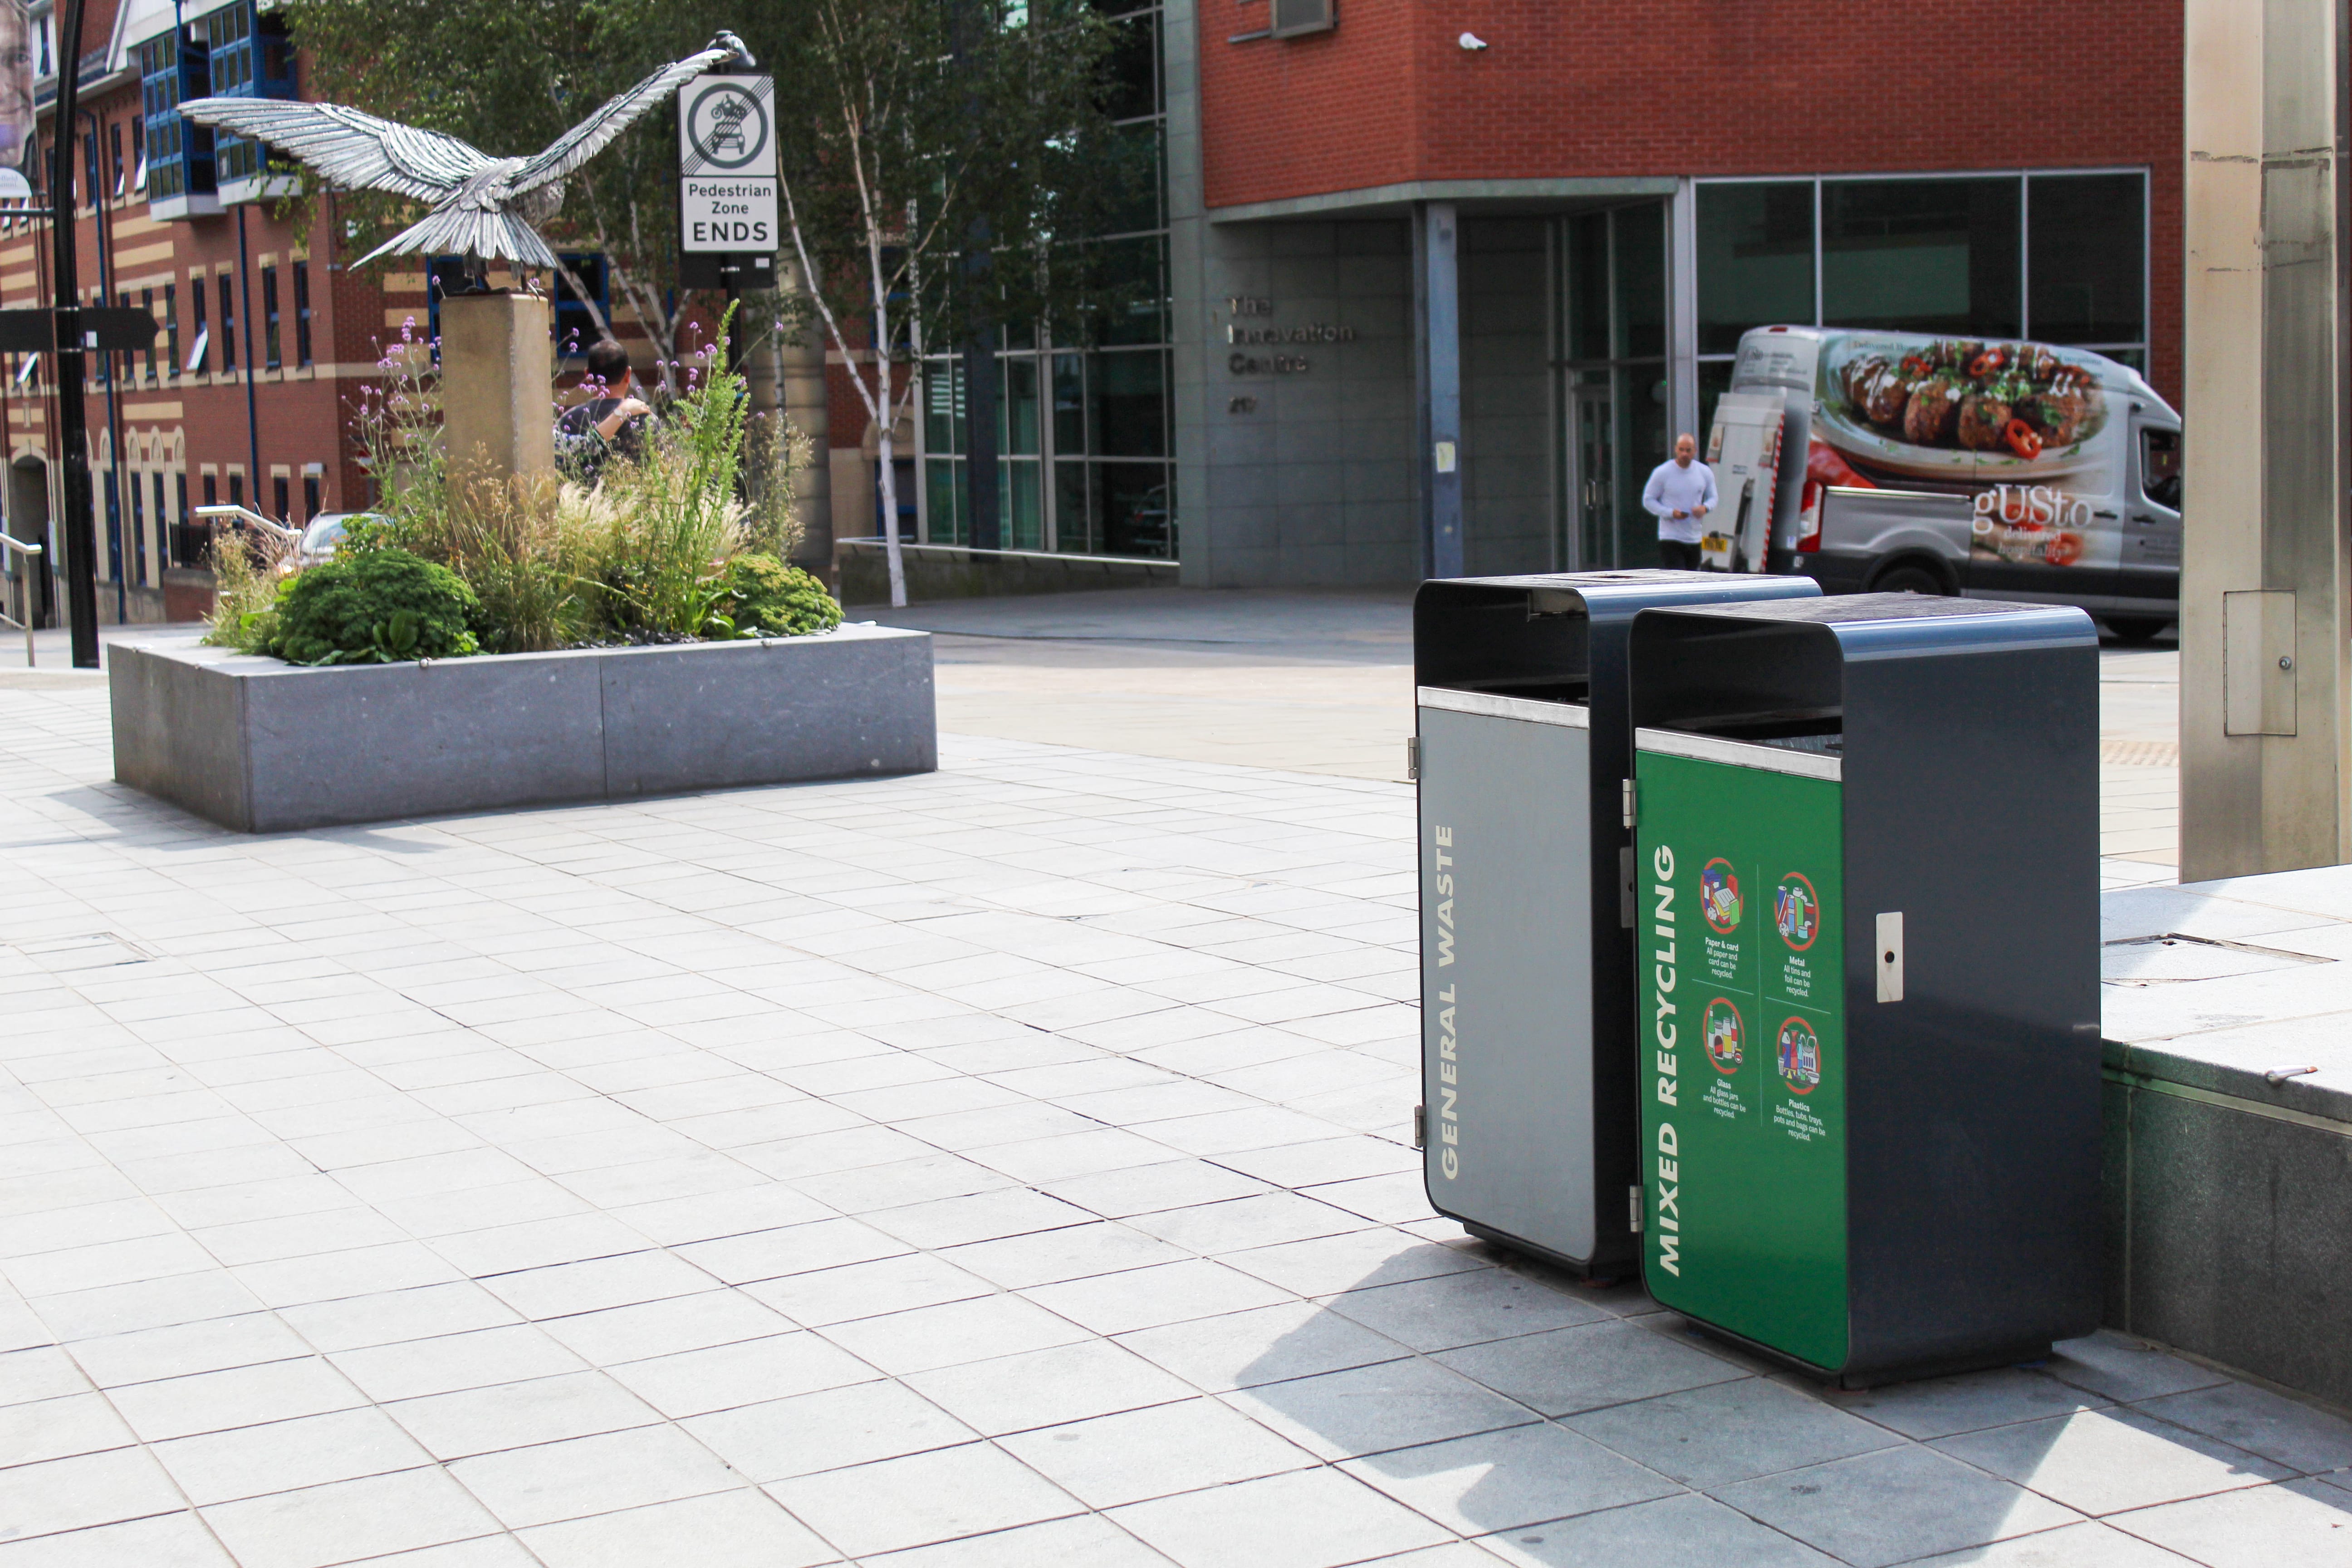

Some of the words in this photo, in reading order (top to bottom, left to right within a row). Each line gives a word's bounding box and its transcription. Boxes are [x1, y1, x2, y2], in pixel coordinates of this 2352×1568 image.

[689, 184, 771, 196] Pedestrian
[712, 201, 749, 214] Zone
[694, 222, 768, 241] ENDS
[2003, 526, 2061, 541] delivered
[1436, 825, 1455, 967] WASTE
[1705, 937, 1720, 947] Paper
[1721, 941, 1726, 949] &
[1713, 950, 1728, 958] paper
[1730, 961, 1736, 970] be
[1789, 956, 1805, 967] Metal
[1654, 845, 1677, 1106] RECYCLING
[1712, 969, 1733, 979] recycled.
[1791, 966, 1800, 975] tins
[1803, 979, 1810, 988] be
[1786, 986, 1809, 997] recycled.
[1439, 983, 1458, 1179] GENERAL
[1717, 1078, 1731, 1089] Glass
[1717, 1088, 1729, 1098] glass
[1729, 1091, 1739, 1101] jars
[1713, 1096, 1730, 1107] bottles
[1740, 1103, 1746, 1112] be
[1788, 1098, 1810, 1112] Plastics
[1714, 1107, 1735, 1118] recycled.
[1776, 1105, 1794, 1117] Bottles,
[1796, 1110, 1808, 1122] tubs,
[1809, 1114, 1823, 1127] trays,
[1774, 1116, 1785, 1124] pots
[1786, 1119, 1795, 1127] and
[1796, 1120, 1808, 1132] bags
[1818, 1127, 1825, 1136] be
[1788, 1130, 1811, 1142] recycled.
[1658, 1123, 1679, 1277] MIXED
